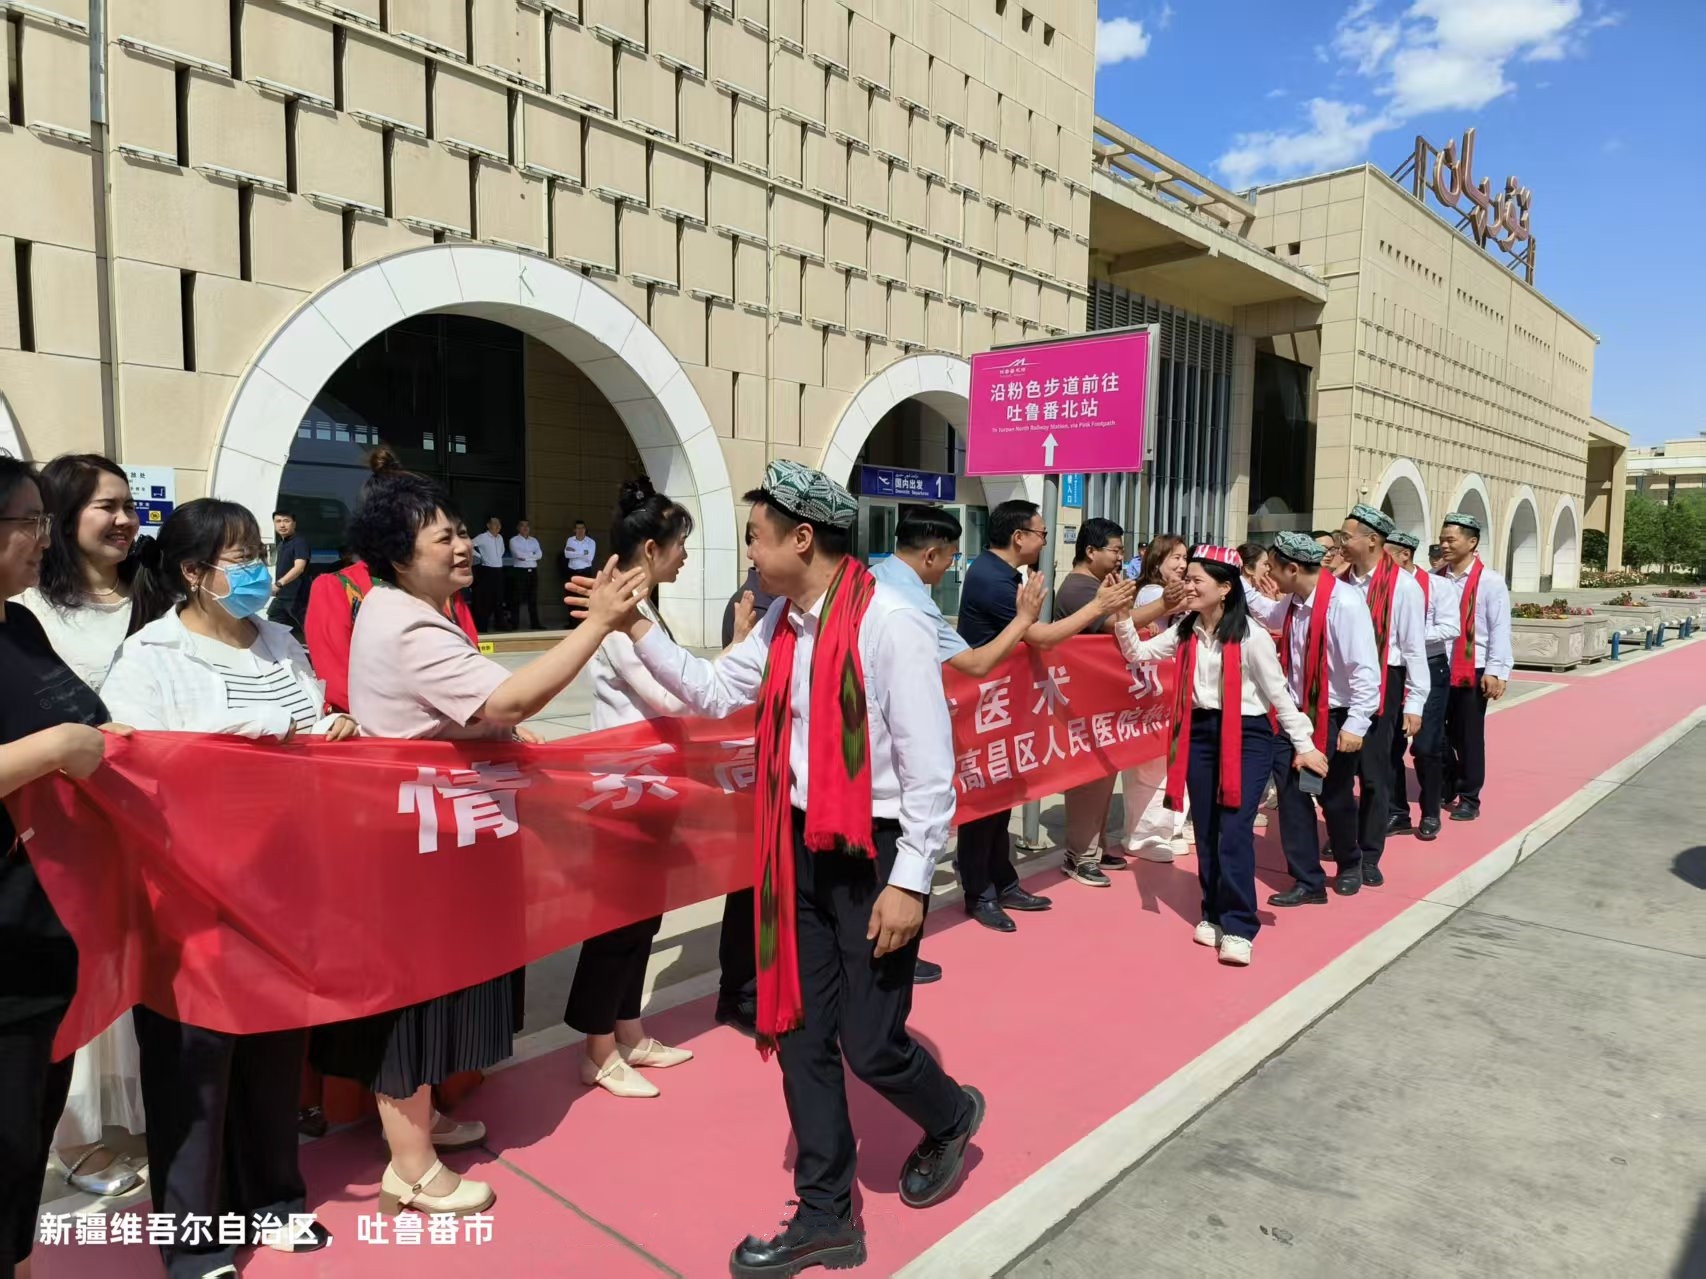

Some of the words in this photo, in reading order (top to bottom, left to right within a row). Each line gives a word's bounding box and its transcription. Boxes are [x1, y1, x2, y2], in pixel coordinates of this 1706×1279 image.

[990, 372, 1119, 402] 沿粉色步道前往
[1007, 397, 1098, 422] 吐鲁番北站
[1030, 424, 1049, 432] Railway
[895, 477, 923, 490] 国内出发
[936, 476, 942, 498] 1
[947, 665, 1071, 734] 医术
[957, 704, 1170, 793] 高昌区人民医院热
